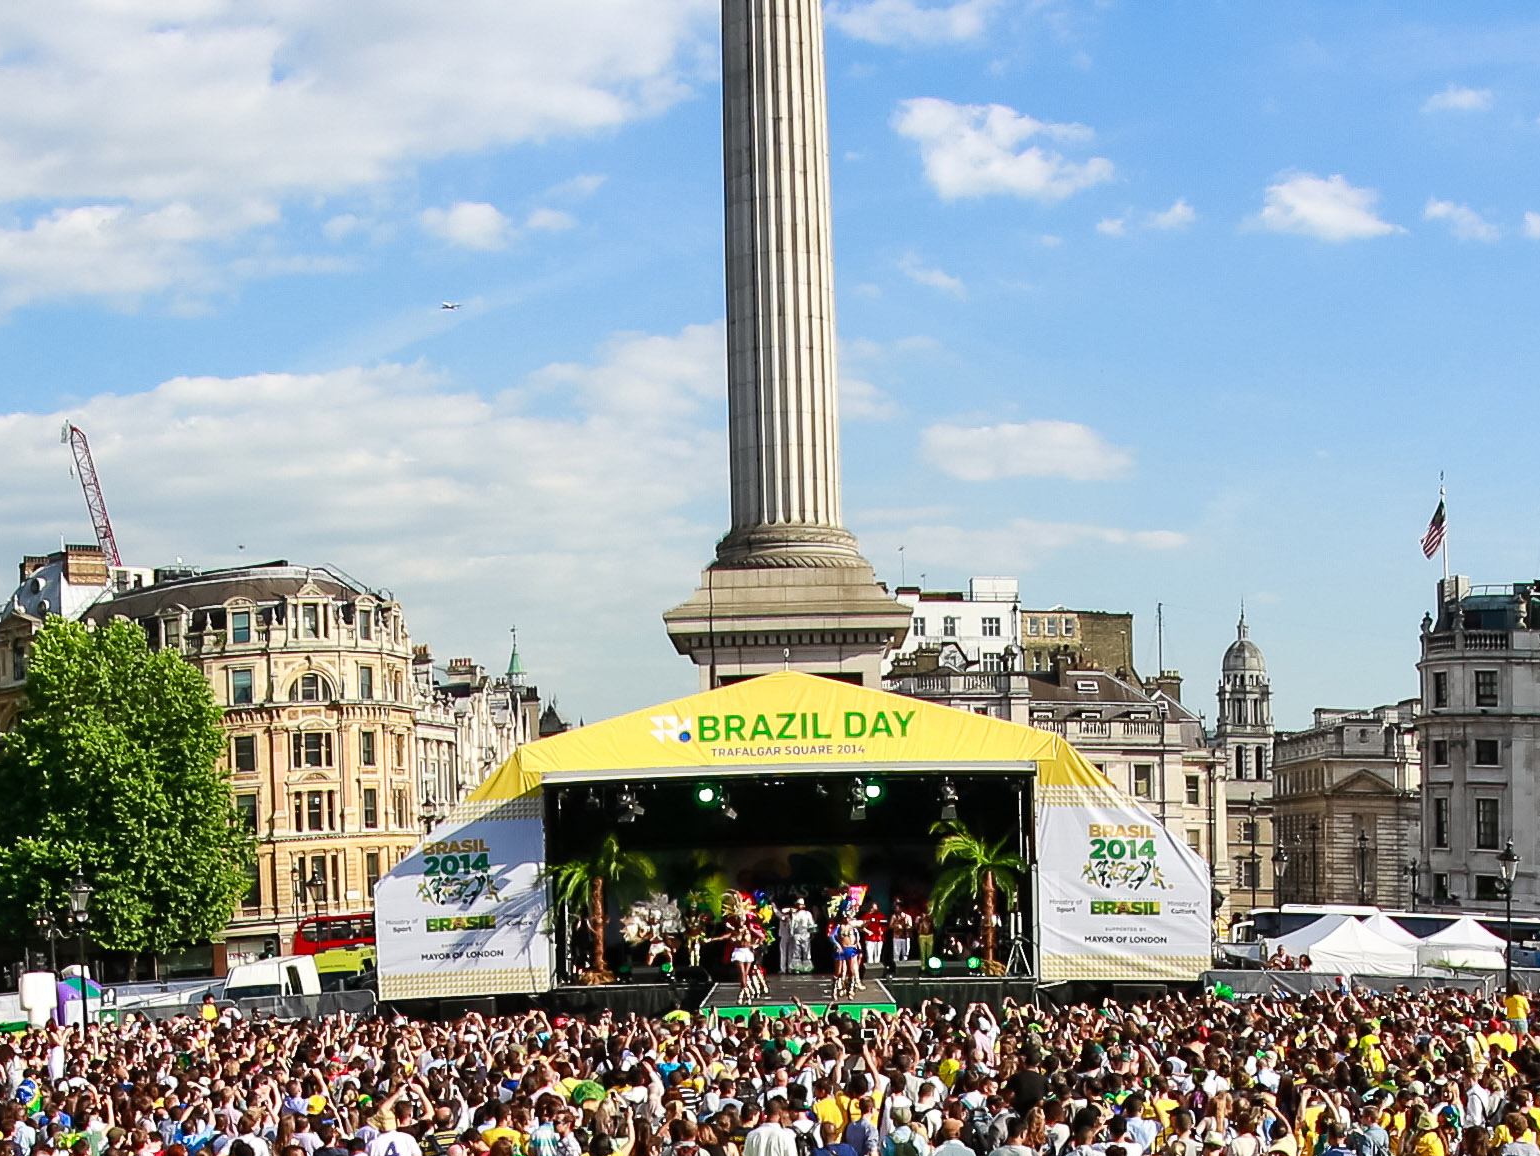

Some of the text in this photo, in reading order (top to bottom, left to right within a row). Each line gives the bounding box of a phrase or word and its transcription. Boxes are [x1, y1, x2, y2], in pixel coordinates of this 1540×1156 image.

[697, 710, 916, 743] BRAZIL DAY
[711, 744, 865, 758] TRAFALGAR SQUARE 2014
[1089, 824, 1156, 838] BRASIL
[422, 839, 490, 856] BRASIL
[1089, 839, 1157, 860] 2014
[423, 853, 491, 876] 2014
[1056, 906, 1076, 914] Sport
[1090, 901, 1161, 915] BRASIL
[426, 915, 496, 932] BRASIL
[1130, 936, 1168, 944] LONDON
[421, 952, 451, 961] MAYOR
[466, 950, 504, 959] LONDON
